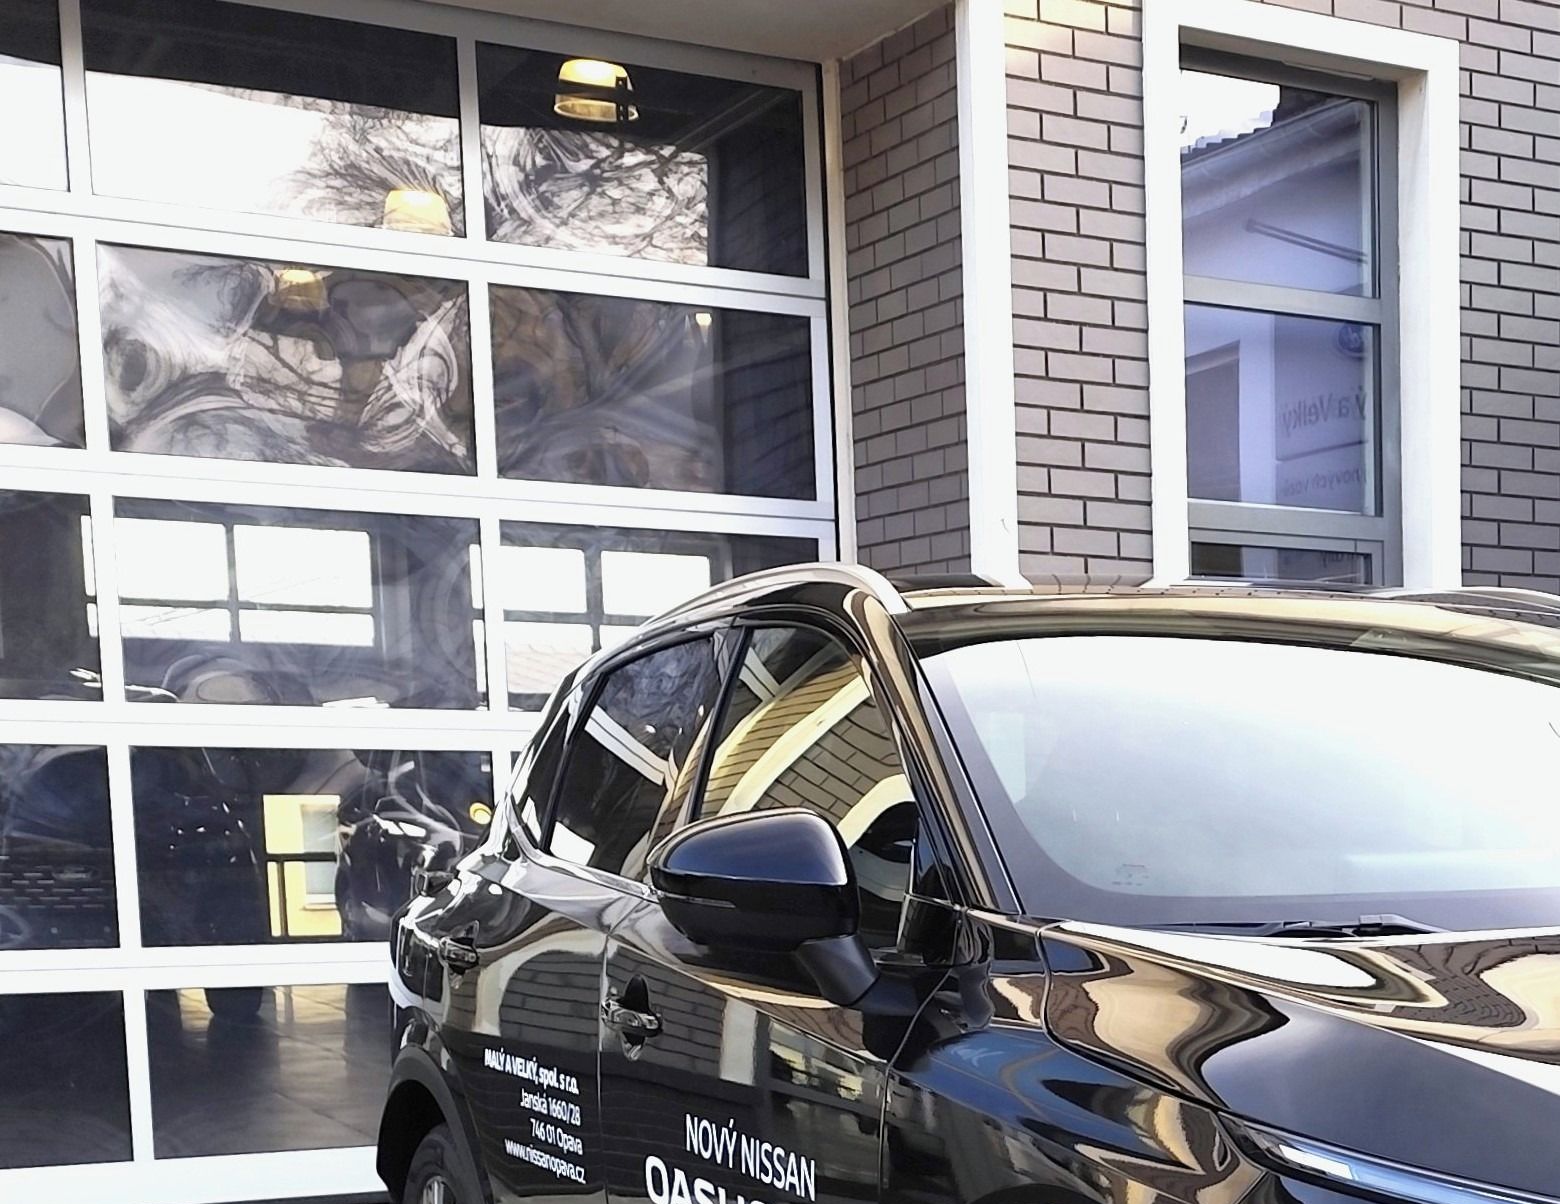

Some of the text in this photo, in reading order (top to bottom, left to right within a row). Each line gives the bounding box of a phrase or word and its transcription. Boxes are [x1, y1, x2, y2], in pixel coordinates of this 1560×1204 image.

[484, 1047, 580, 1095] MALÝ A VELKÝ, spol. s r.o.
[520, 1088, 581, 1126] Janská 1660/28
[530, 1117, 583, 1155] 746 01 Opava
[685, 1114, 816, 1202] NOVÝ NISSAN
[504, 1138, 587, 1184] www.nissanopava.cz
